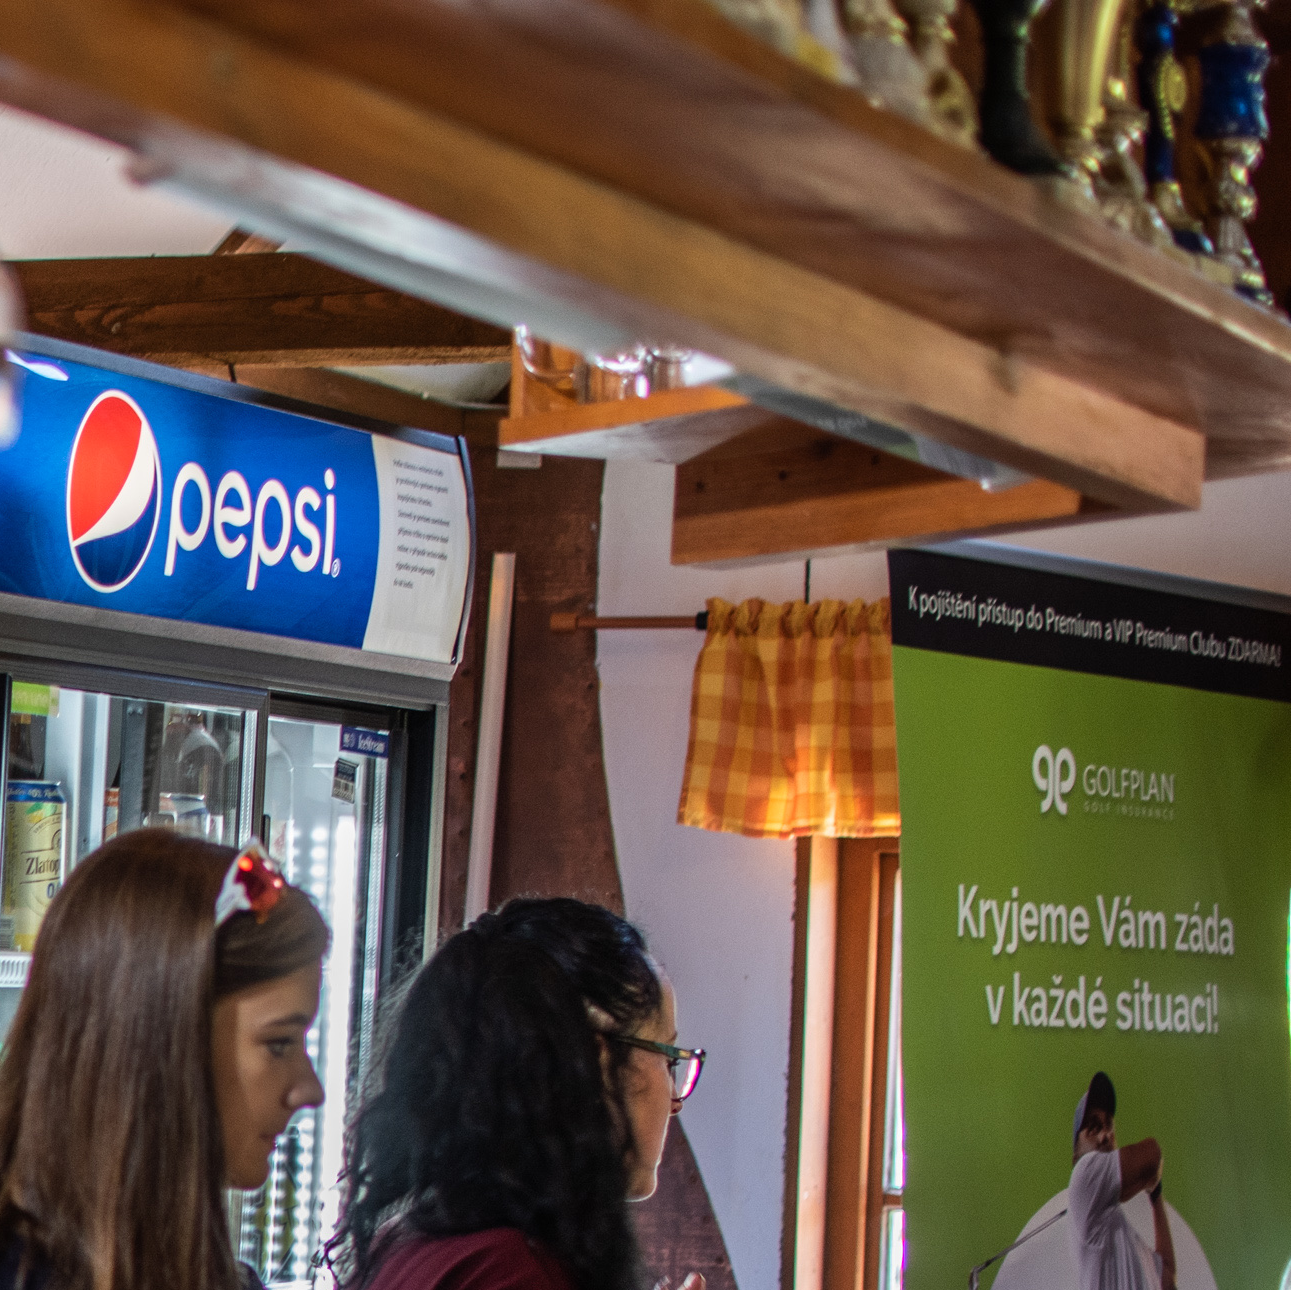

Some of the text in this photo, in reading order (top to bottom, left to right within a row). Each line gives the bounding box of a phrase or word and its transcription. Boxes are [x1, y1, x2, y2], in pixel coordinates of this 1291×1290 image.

[163, 461, 336, 592] pepsi
[908, 585, 919, 612] K
[919, 589, 977, 622] pojištění
[977, 597, 1025, 633] přístup
[1026, 604, 1044, 631] do
[1045, 606, 1103, 640] Premium
[1105, 621, 1113, 641] a
[1113, 618, 1133, 645] VIP
[1135, 620, 1188, 653] Premium
[1189, 630, 1227, 660] Clubu
[1083, 764, 1175, 803] GOLFPLAN
[957, 883, 1236, 956] Kryjeme Vám záda
[985, 971, 1219, 1034] v každé situaci!
